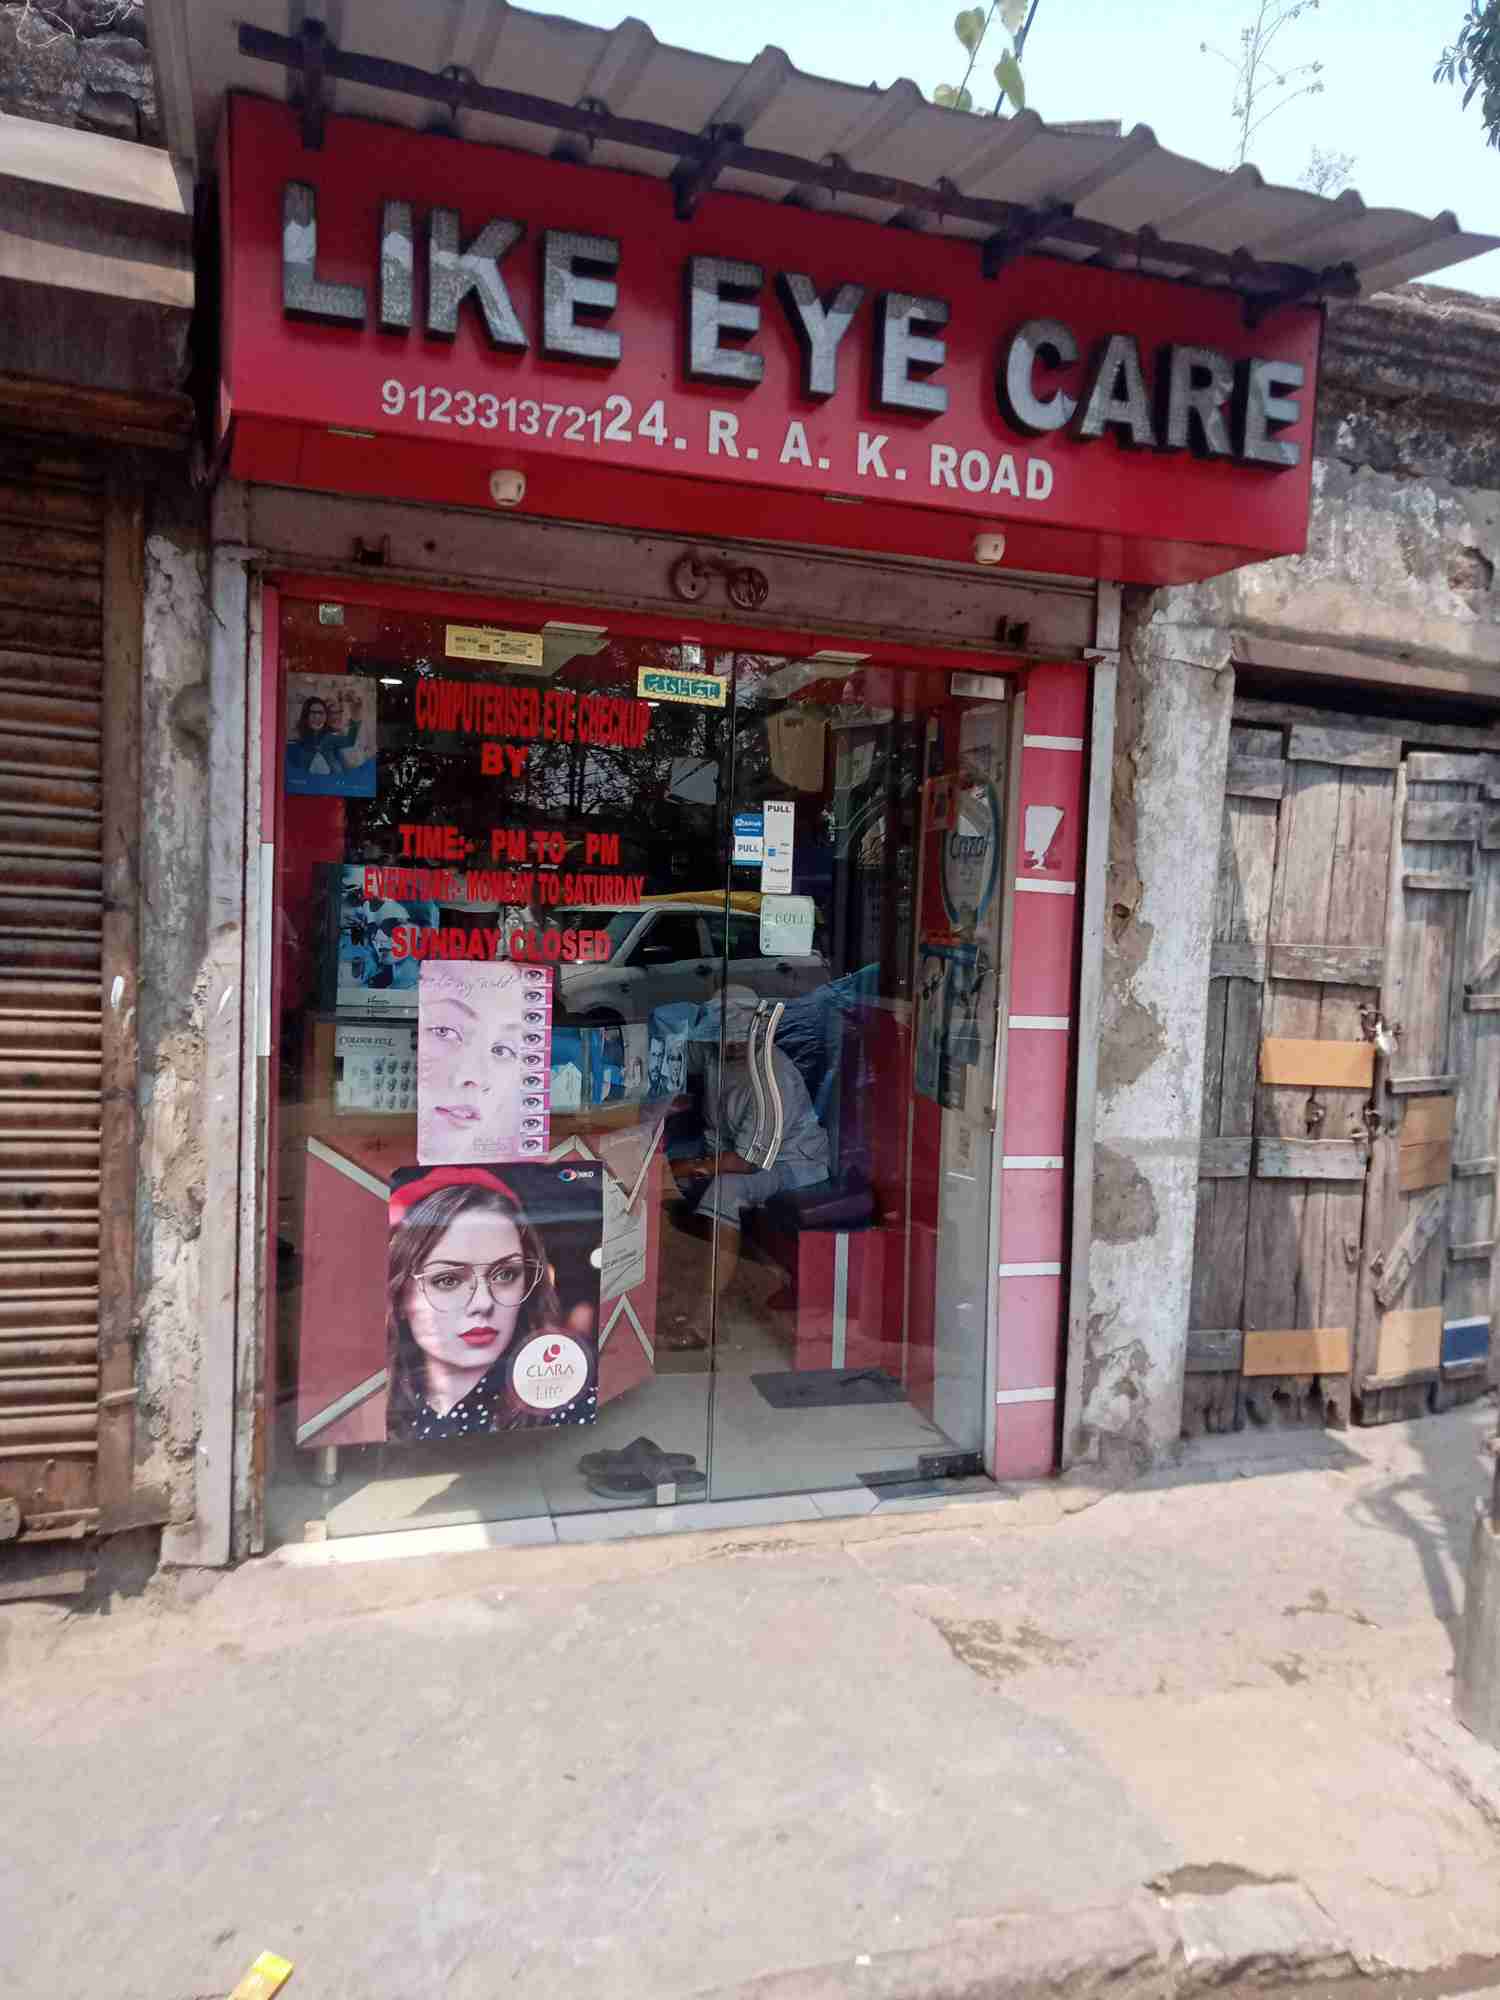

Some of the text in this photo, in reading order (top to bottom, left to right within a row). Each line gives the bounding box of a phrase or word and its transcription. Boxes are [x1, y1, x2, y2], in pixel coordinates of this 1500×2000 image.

[283, 179, 1304, 470] LIKE EYE CARE
[929, 443, 1054, 501] ROAD
[415, 678, 650, 749] COMPUTERISED EYE CHECKUP
[480, 741, 529, 778] BY
[767, 804, 792, 813] PULL
[490, 828, 527, 864] PM
[530, 830, 568, 865] TO
[584, 832, 621, 866] PM
[737, 843, 760, 854] PULL
[465, 869, 534, 905] MONDAY
[537, 872, 560, 903] TO
[562, 873, 646, 906] SATURDAY
[390, 925, 613, 962] SUNDAY CLOSED
[526, 1362, 575, 1378] CLARA
